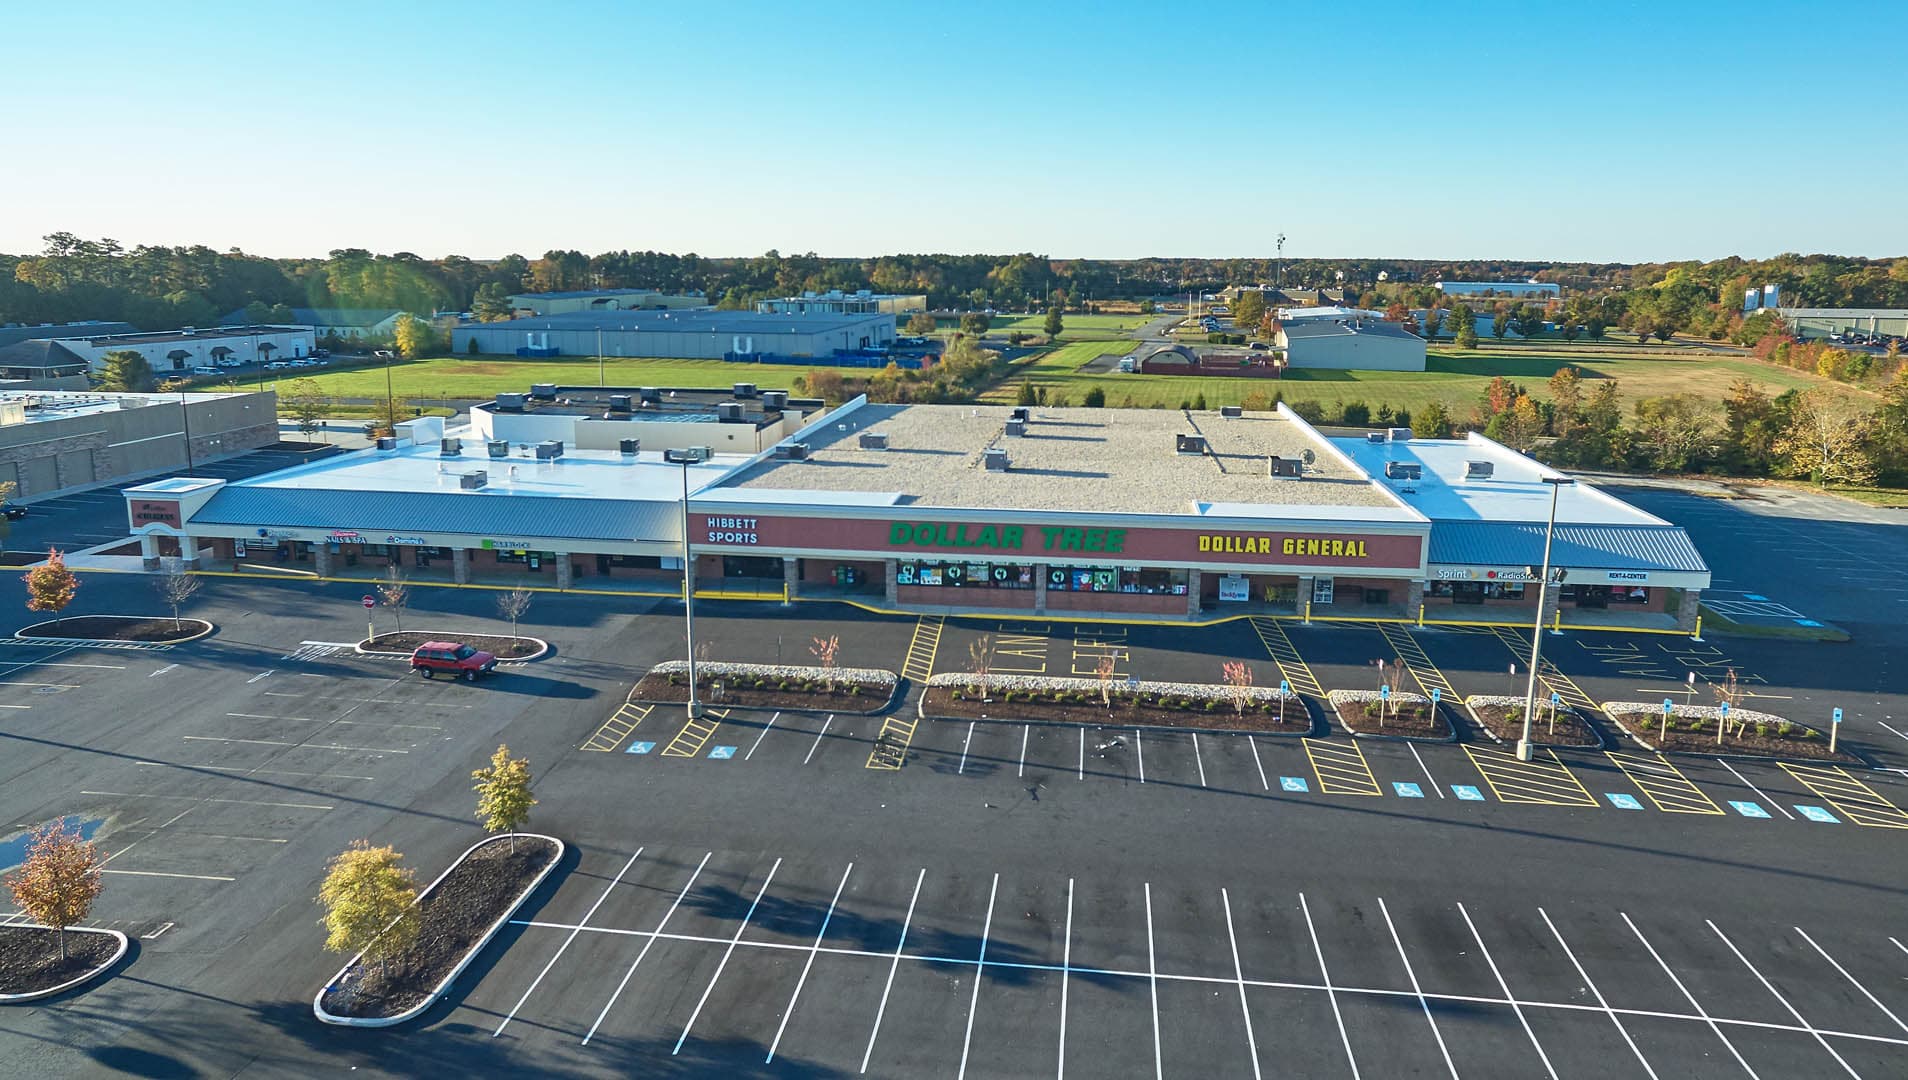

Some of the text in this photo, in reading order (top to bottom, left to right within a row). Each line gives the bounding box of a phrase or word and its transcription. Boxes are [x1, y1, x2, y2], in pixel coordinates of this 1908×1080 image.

[708, 518, 757, 529] HIBBETT
[709, 532, 757, 543] SPORTS
[889, 521, 1127, 552] DOLLAR TREE
[1199, 535, 1367, 557] DOLLAR GENERAL
[1438, 569, 1466, 579] Sprint
[1609, 572, 1647, 580] RENT-A-CENTER
